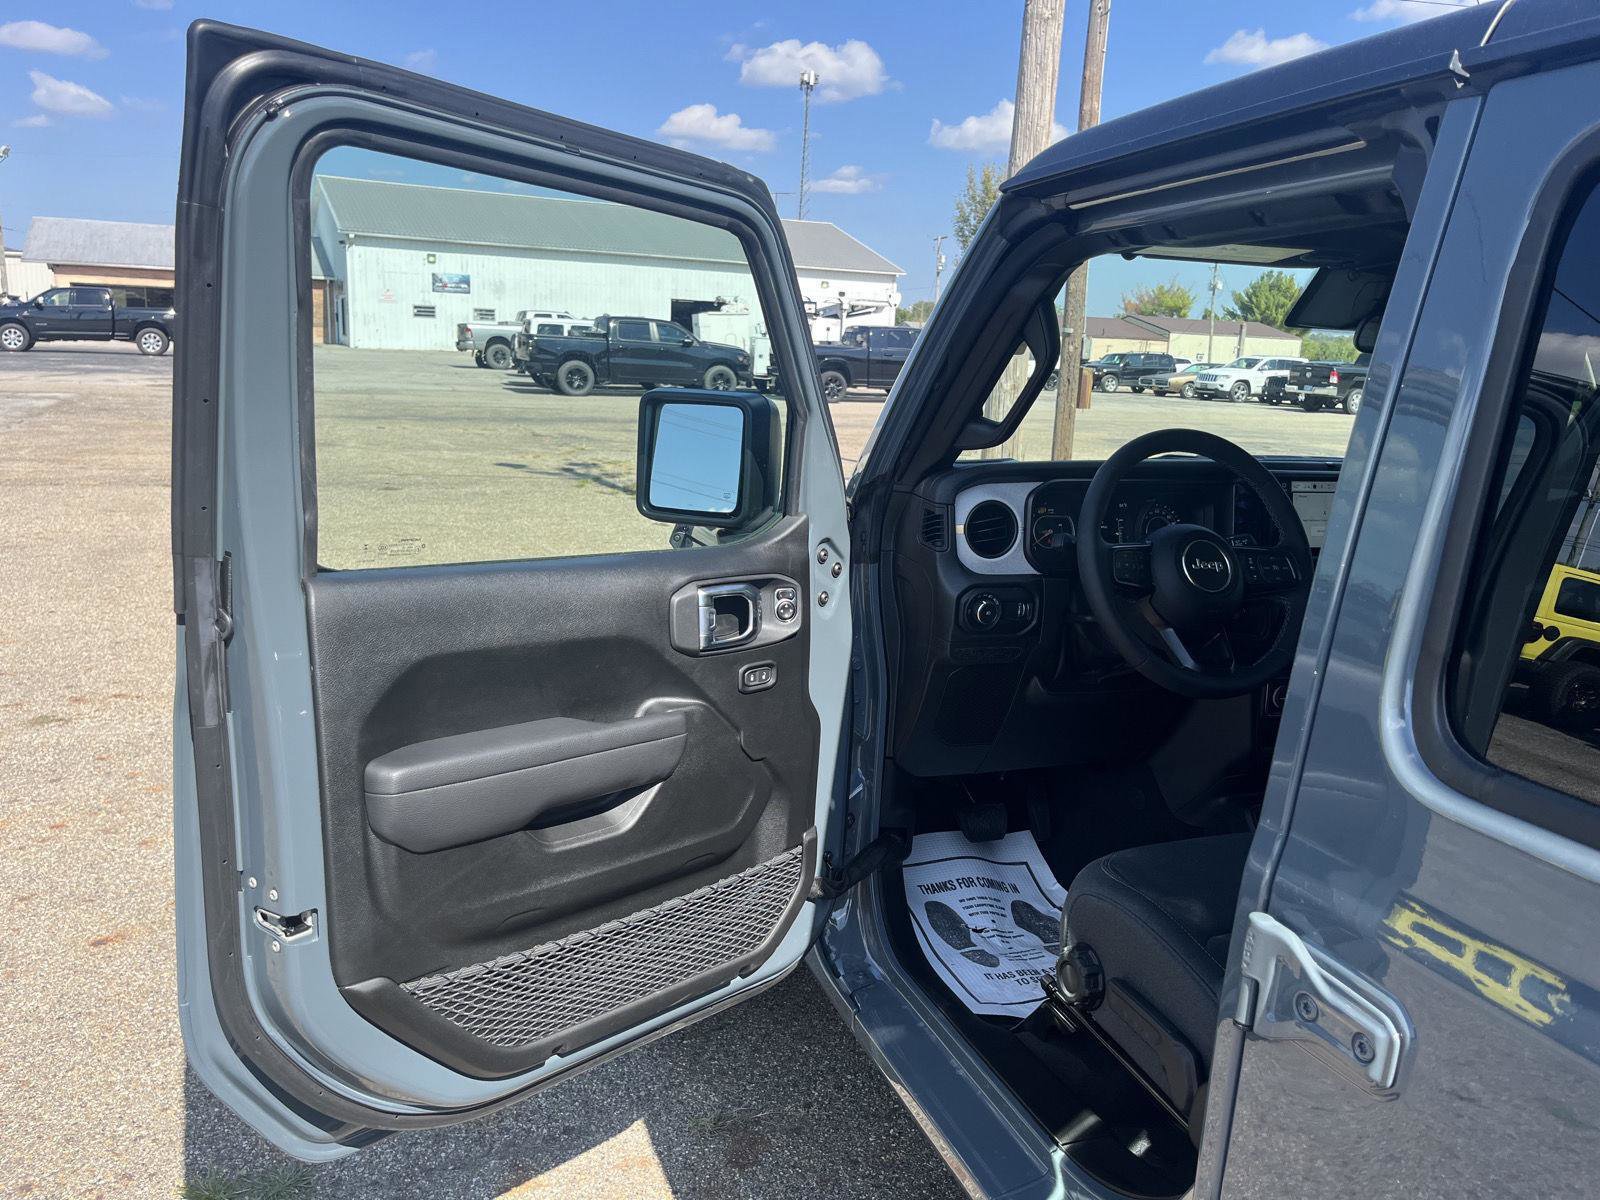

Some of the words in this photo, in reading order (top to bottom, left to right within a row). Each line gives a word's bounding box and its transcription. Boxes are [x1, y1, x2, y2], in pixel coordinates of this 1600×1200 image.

[1192, 558, 1223, 572] Jeep
[917, 879, 957, 895] THANKS
[956, 876, 977, 889] FOR
[976, 876, 1010, 893] COMING
[1008, 882, 1020, 895] IN
[983, 972, 994, 980] IT
[994, 971, 1016, 980] HAS
[1015, 968, 1041, 977] BEEN
[1014, 977, 1030, 986] TO
